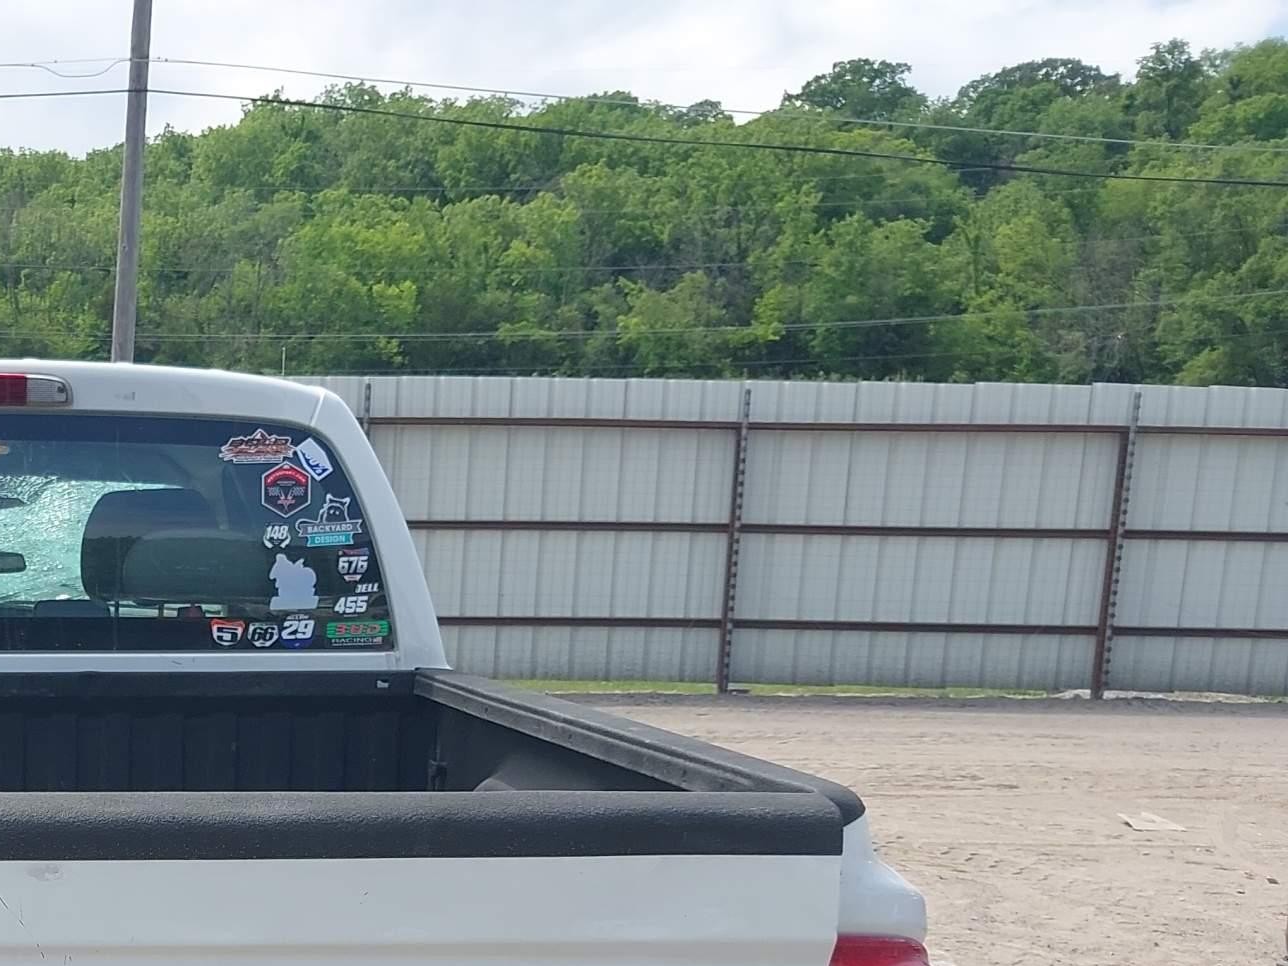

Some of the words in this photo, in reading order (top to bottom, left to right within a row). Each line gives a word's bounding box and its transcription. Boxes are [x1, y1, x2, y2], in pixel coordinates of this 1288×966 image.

[266, 525, 289, 540] 148
[307, 523, 352, 533] BACKYARD
[315, 534, 346, 544] DESIGN
[334, 595, 368, 613] 455
[281, 620, 315, 640] 29
